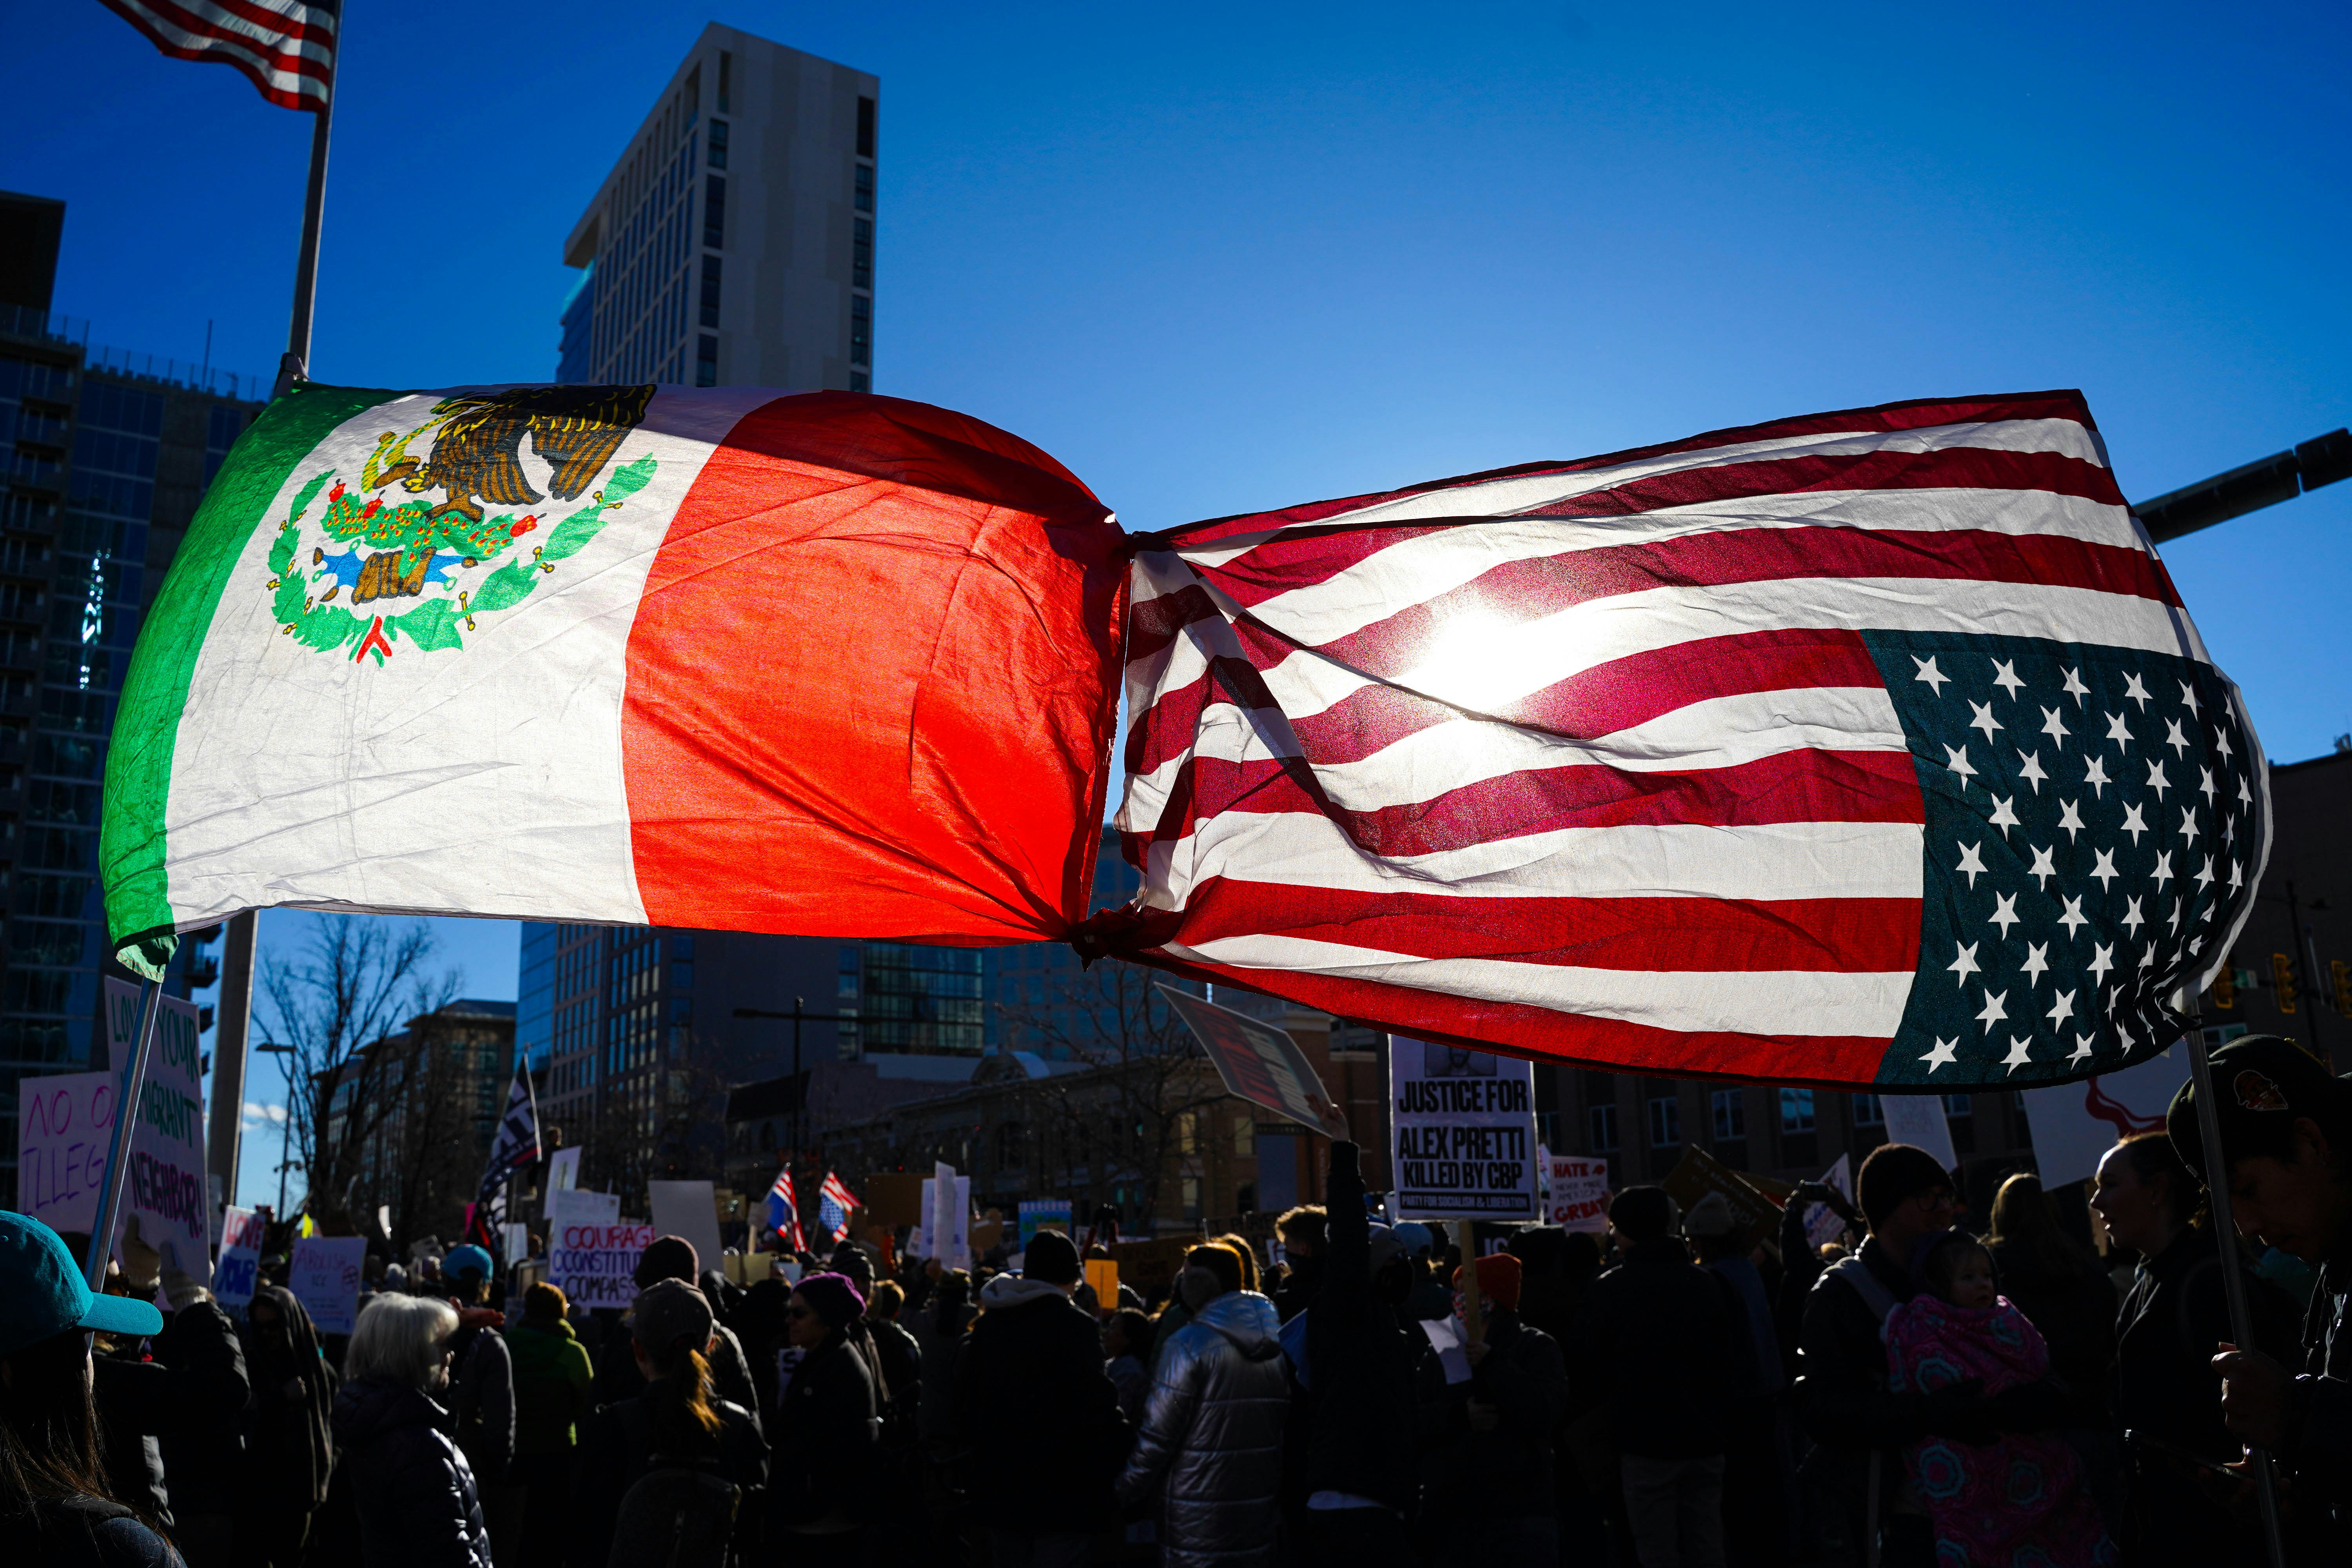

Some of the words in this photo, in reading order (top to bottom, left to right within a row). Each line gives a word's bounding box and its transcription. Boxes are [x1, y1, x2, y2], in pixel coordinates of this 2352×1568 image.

[111, 994, 138, 1043] LOV
[156, 1004, 199, 1082] YOUR
[1399, 1080, 1483, 1112] JUSTICE
[1486, 1080, 1528, 1112] FOR
[25, 1090, 72, 1142] NO
[1398, 1127, 1449, 1159] ALEX
[1453, 1127, 1525, 1160] PRETTI
[23, 1143, 104, 1216] ILLEG
[1404, 1162, 1459, 1188] KILLED
[1463, 1162, 1484, 1188] BY
[1488, 1162, 1523, 1189] CBP
[1553, 1163, 1588, 1178] HATE
[130, 1152, 203, 1238] NEIGHBOR!
[1401, 1195, 1423, 1207] PARTY
[1423, 1195, 1437, 1207] FOR
[1437, 1195, 1475, 1208] SOCIALISM
[1486, 1196, 1528, 1209] LIBERATION
[1554, 1198, 1604, 1222] GREAT
[225, 1212, 263, 1250] LOVE
